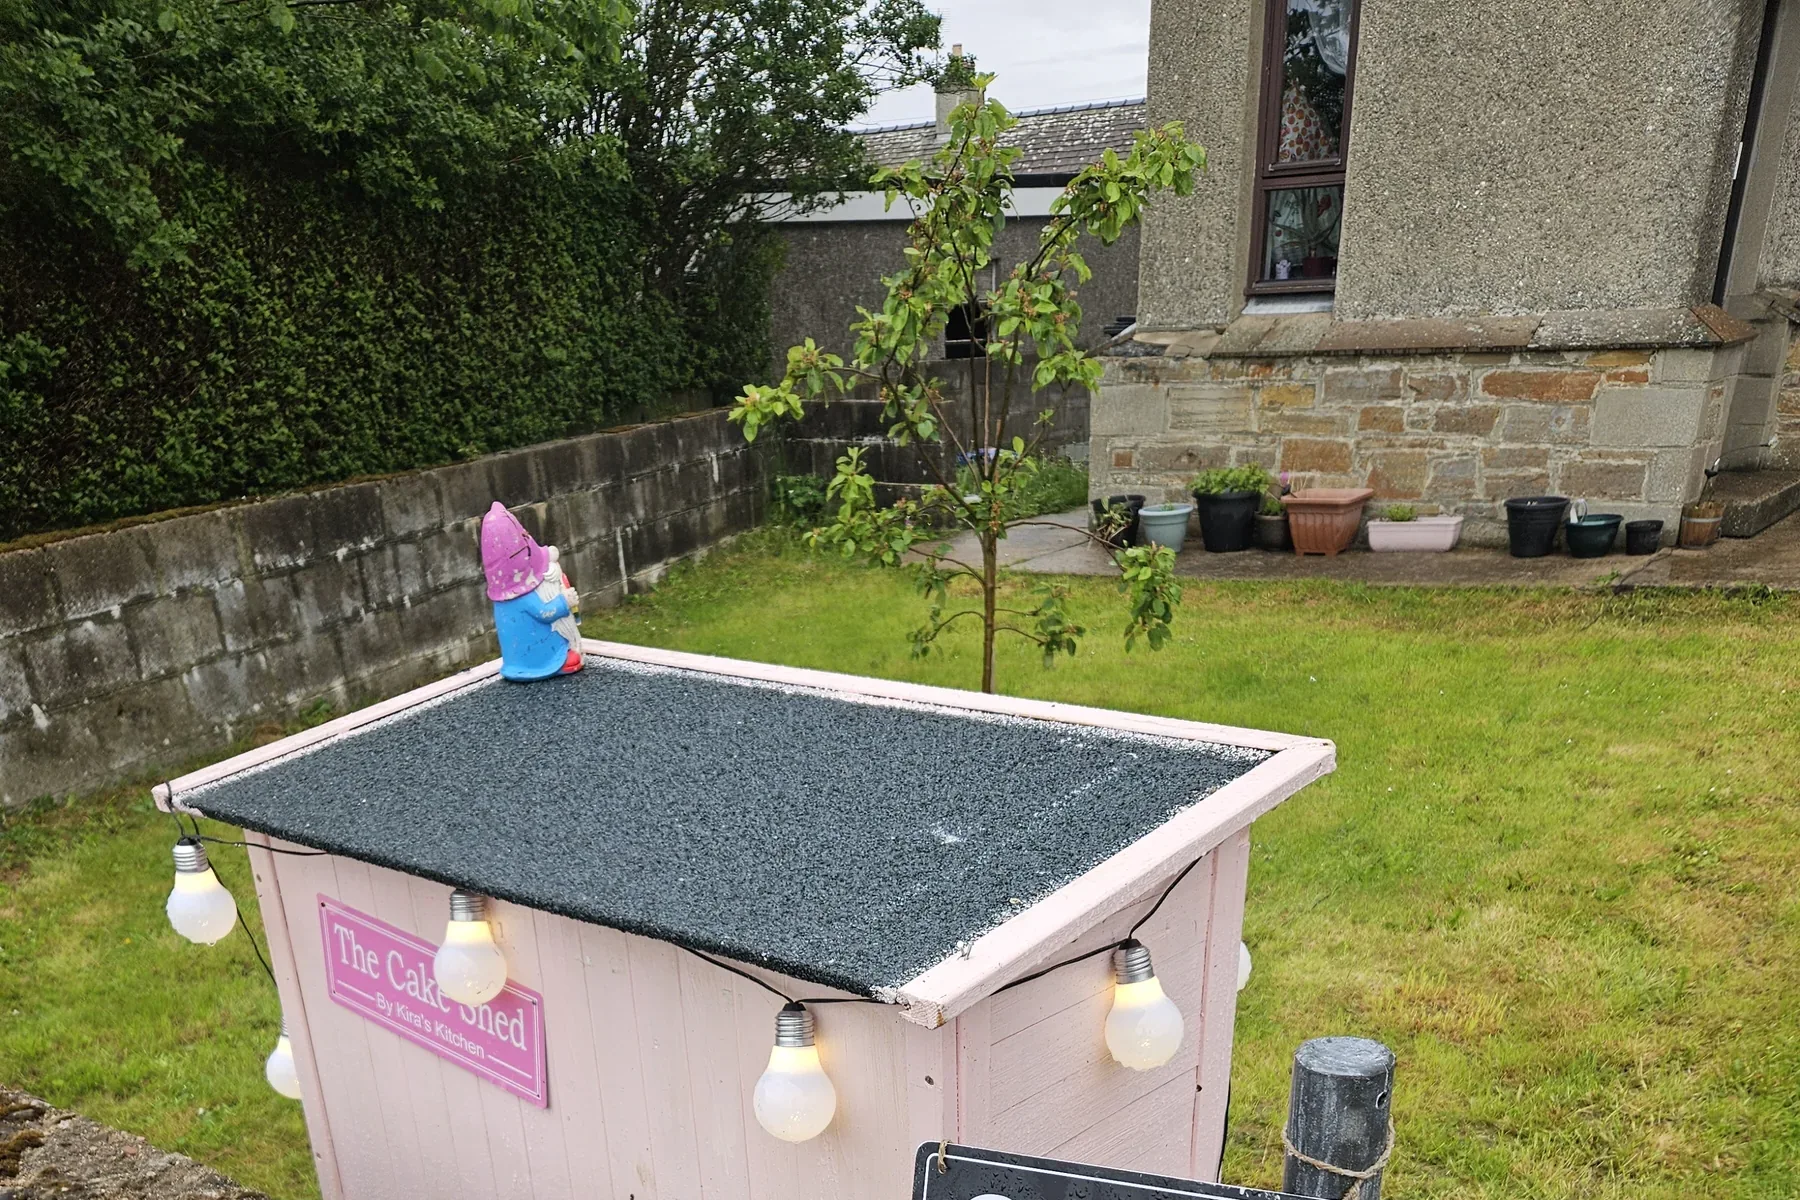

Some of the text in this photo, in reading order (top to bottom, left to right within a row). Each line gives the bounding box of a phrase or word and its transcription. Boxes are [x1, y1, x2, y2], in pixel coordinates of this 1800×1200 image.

[333, 924, 380, 979] The
[387, 950, 451, 1013] Cake
[375, 992, 486, 1059] By Kira's Kitchen
